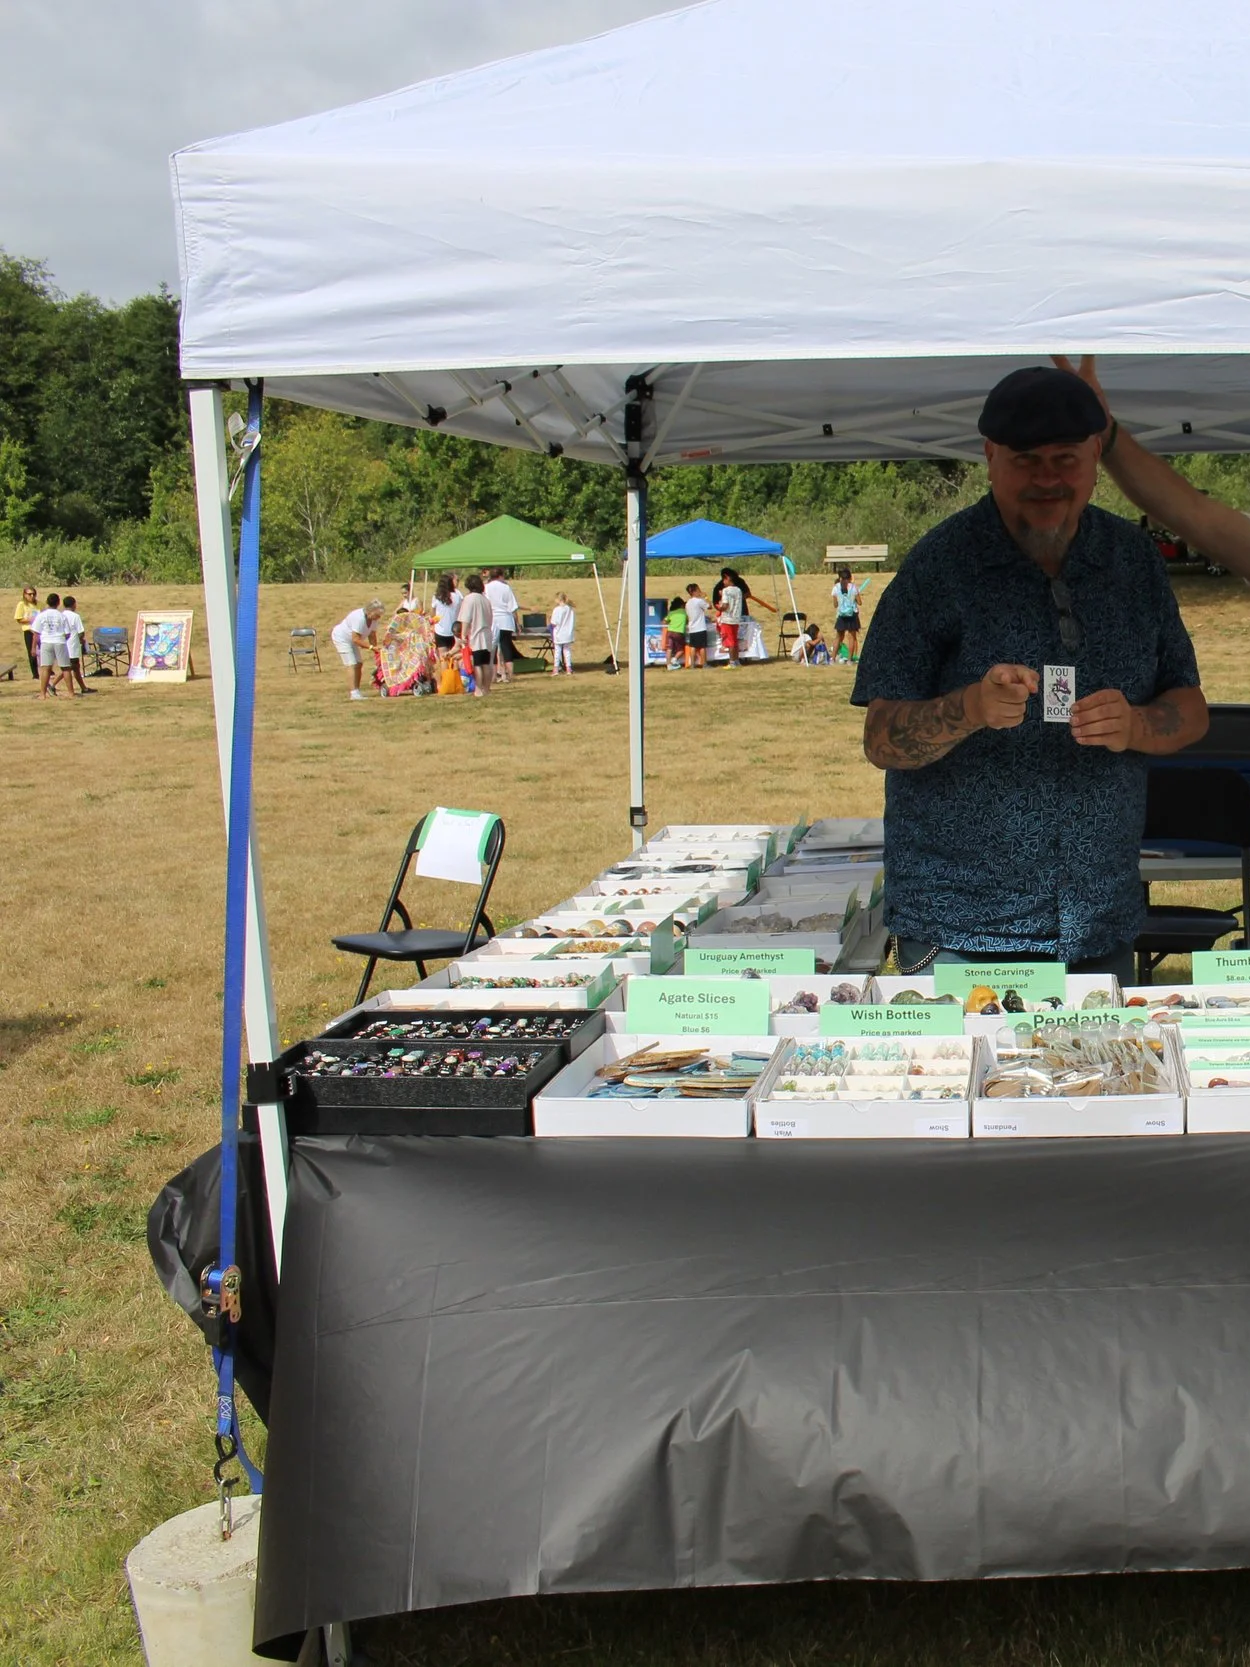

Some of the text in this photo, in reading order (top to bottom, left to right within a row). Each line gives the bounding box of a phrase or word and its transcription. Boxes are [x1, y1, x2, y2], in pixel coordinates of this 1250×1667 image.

[1049, 667, 1069, 677] YOU
[1046, 706, 1072, 716] ROCK
[699, 952, 785, 962] Uruguay Amethyst
[964, 968, 1035, 977] Stone Carvings
[658, 991, 736, 1006] Agate Slices
[674, 1012, 719, 1021] Natural $15
[850, 1009, 932, 1021] Wish Bottles
[681, 1025, 711, 1034] Blue $6
[770, 1120, 796, 1128] Bottles
[928, 1124, 950, 1132] Show
